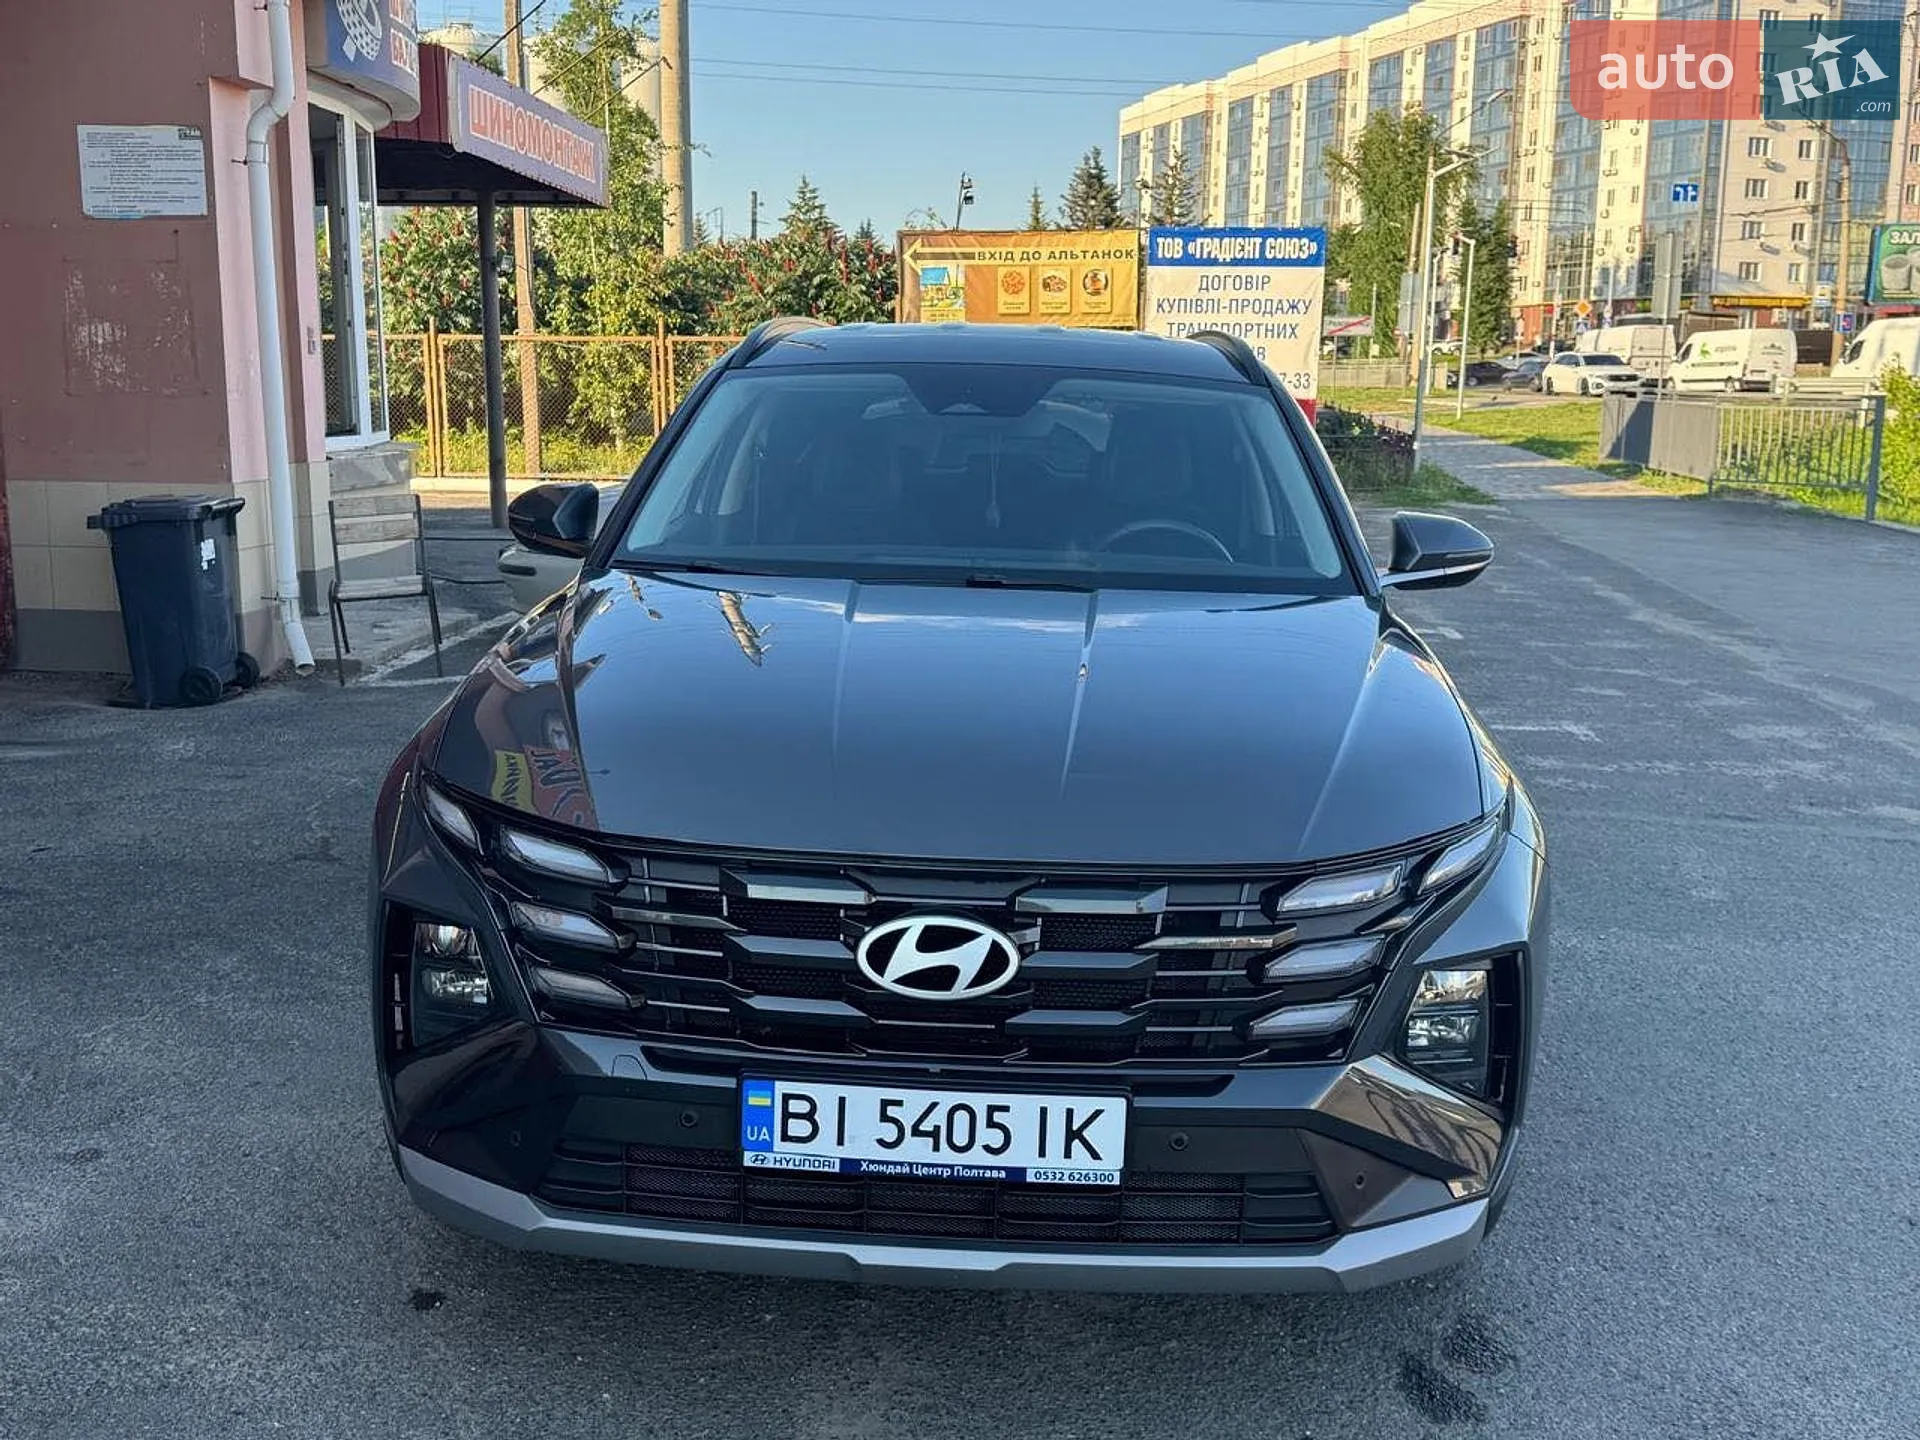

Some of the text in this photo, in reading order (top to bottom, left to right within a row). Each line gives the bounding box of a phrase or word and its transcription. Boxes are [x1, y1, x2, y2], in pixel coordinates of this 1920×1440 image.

[469, 84, 596, 184] ШИНОМОНТАЖ
[978, 248, 1134, 263] ВХІД ДО АЛЬТАНОК
[1156, 237, 1184, 260] ТОВ
[1265, 237, 1318, 260] СОЮЗ»
[1198, 274, 1272, 293] ДОГОВІР
[1156, 298, 1313, 317] КУПІВЛІ-ПРОДАЖУ
[746, 1126, 771, 1142] UA
[780, 1092, 1106, 1161] BI 5405 IK
[773, 1156, 837, 1171] HYUNDAI
[860, 1160, 1007, 1179] Хюндай Центр Полтава
[1034, 1170, 1115, 1184] 0532 626300
